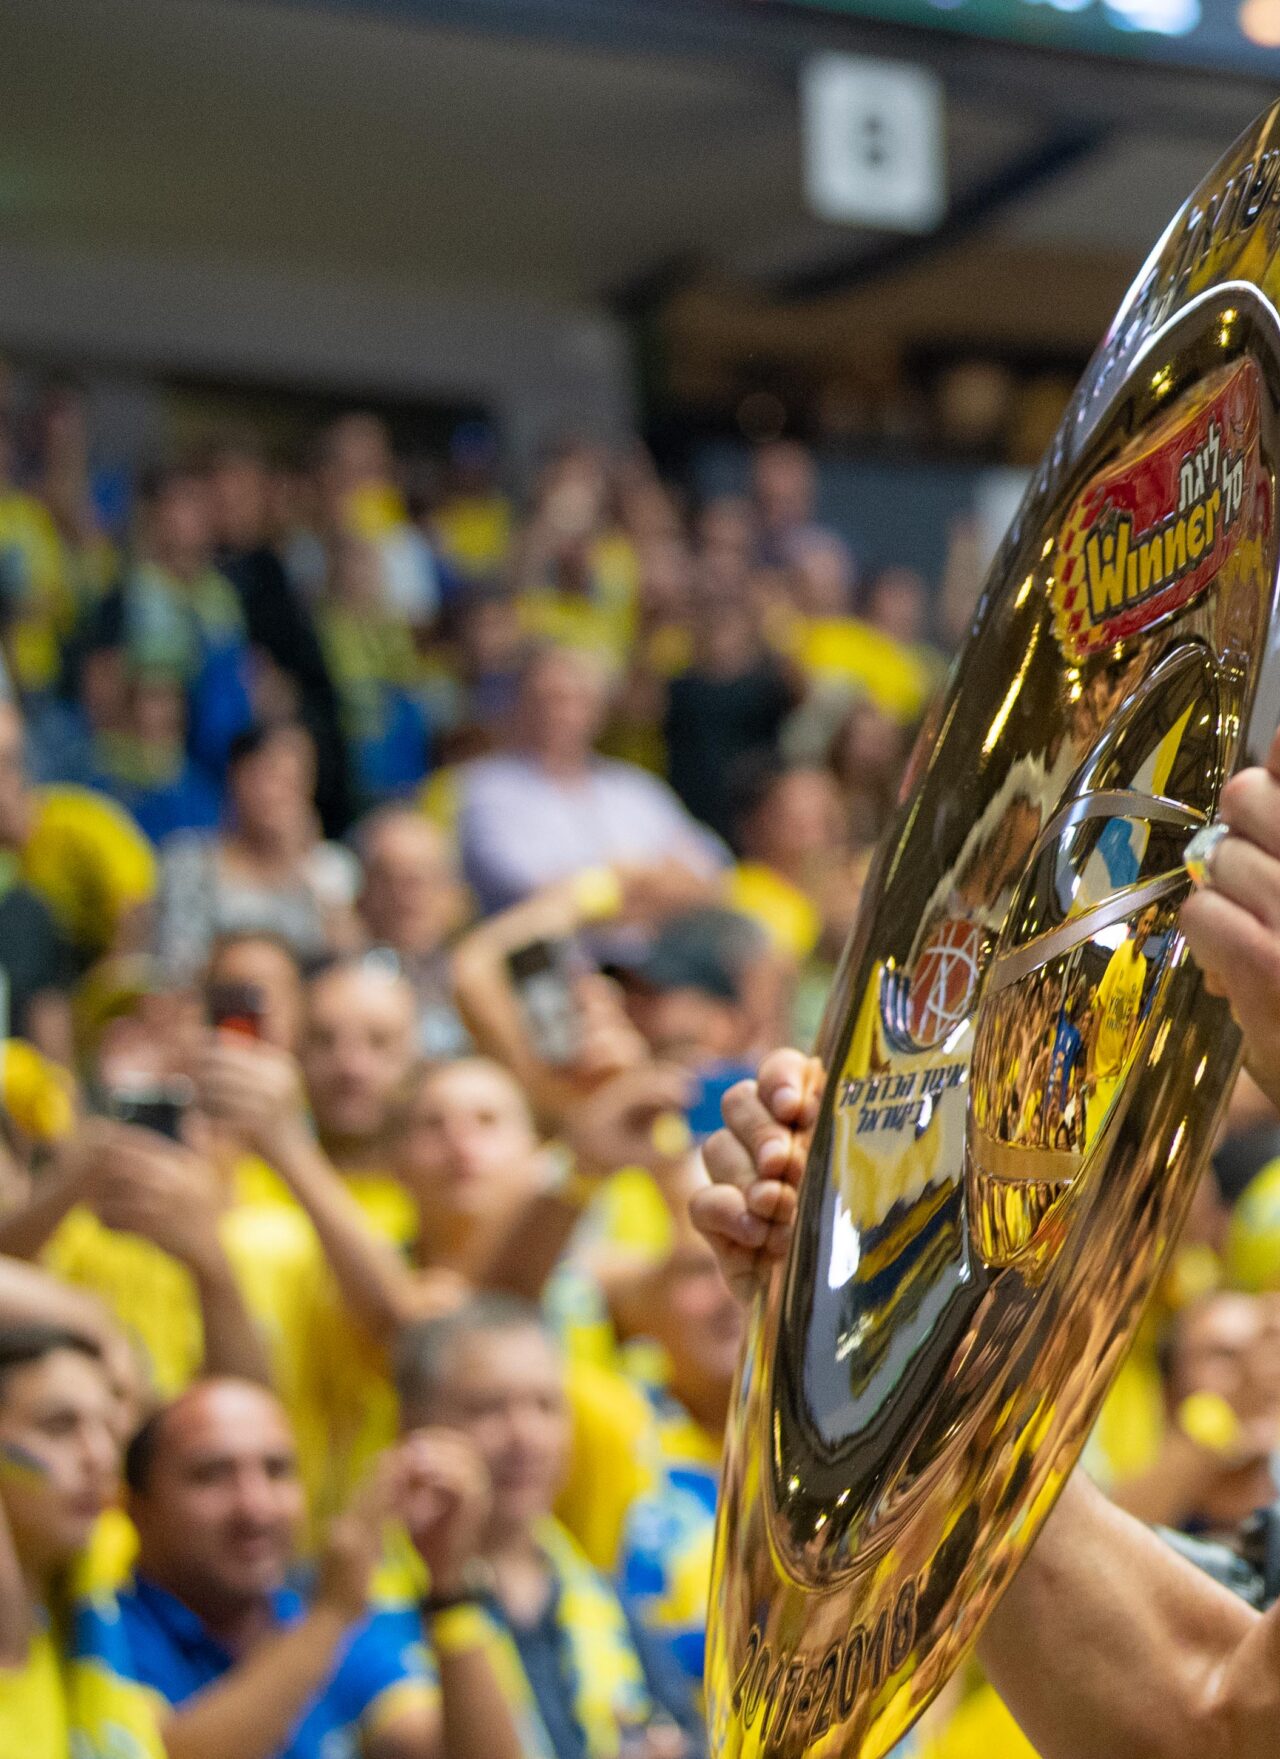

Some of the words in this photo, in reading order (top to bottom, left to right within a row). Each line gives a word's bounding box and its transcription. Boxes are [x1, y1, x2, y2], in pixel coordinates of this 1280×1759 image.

[1178, 422, 1221, 513] ליגת
[1222, 455, 1244, 526] סל
[1085, 486, 1221, 617] Winner
